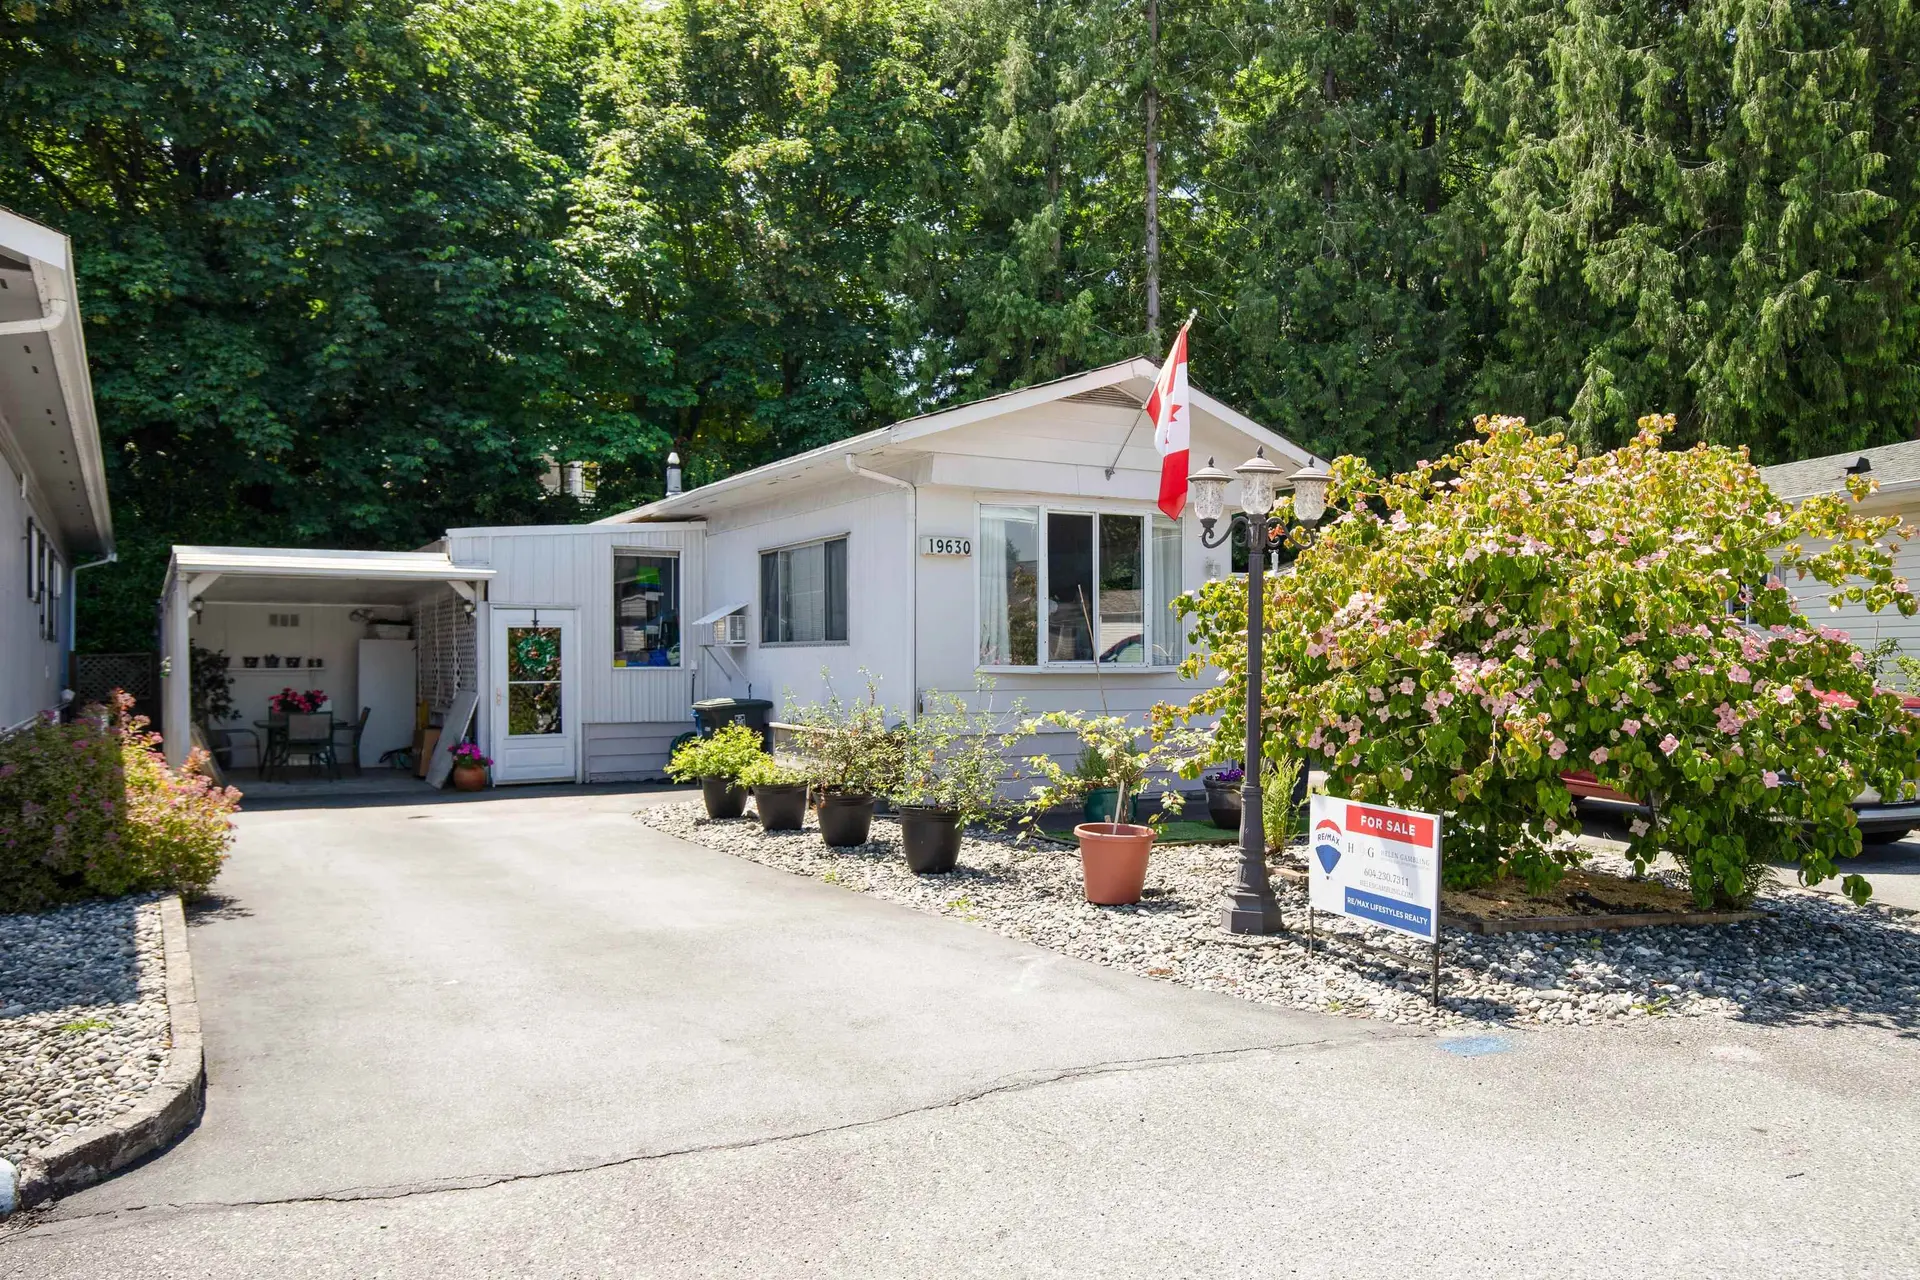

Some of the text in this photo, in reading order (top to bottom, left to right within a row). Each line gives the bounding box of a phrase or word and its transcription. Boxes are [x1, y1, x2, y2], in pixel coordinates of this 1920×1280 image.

[929, 538, 971, 555] 19630
[1360, 815, 1416, 836] FOR SALE
[1317, 833, 1340, 845] RE/MAX
[1367, 846, 1374, 858] G
[1363, 867, 1409, 887] 604.230.7311
[1347, 896, 1428, 926] RE/MAX LIFESTYLES REALTY
